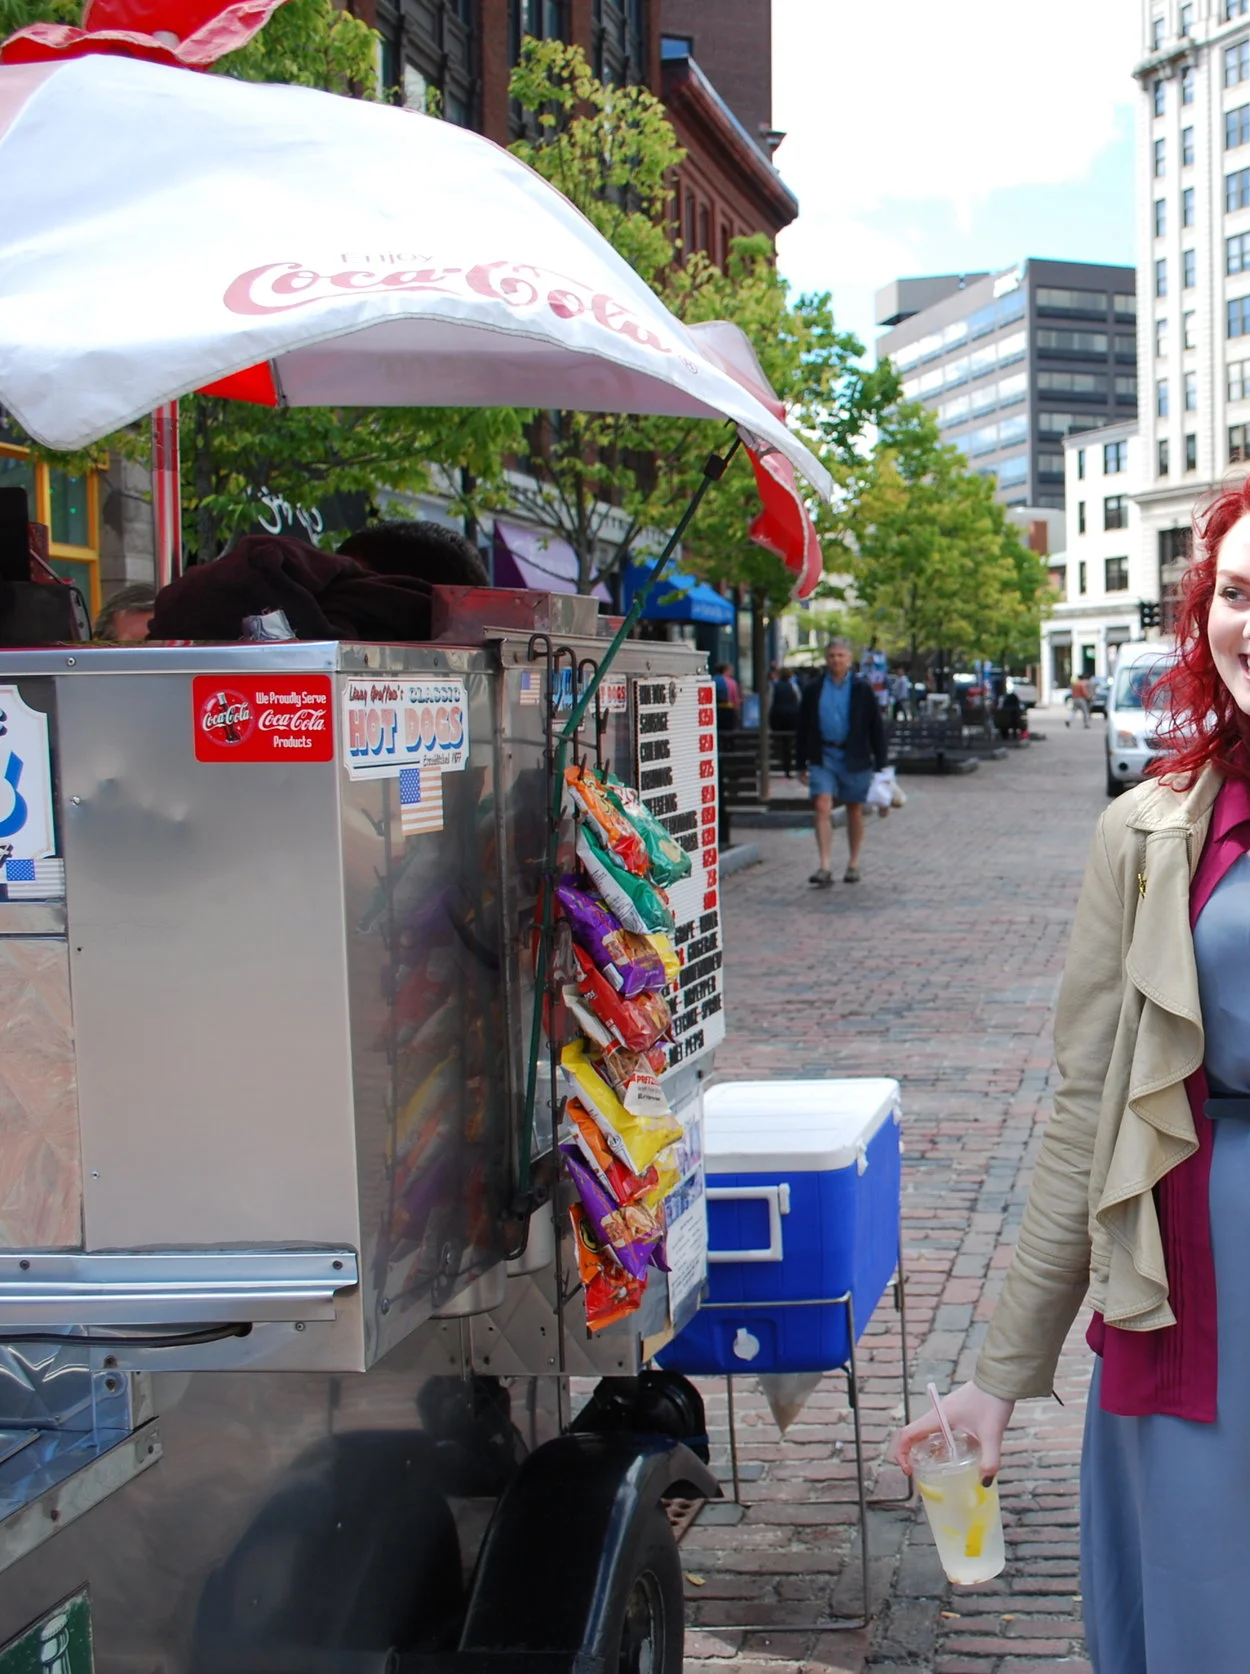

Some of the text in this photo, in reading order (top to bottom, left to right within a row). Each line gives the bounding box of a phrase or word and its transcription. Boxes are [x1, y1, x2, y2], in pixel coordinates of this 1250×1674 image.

[339, 250, 434, 265] Enjoy
[222, 260, 672, 354] Coca-Cola
[255, 691, 327, 707] We Proudly Serve
[408, 686, 461, 703] CLASSIC
[202, 701, 250, 732] Coca-Cola
[258, 709, 327, 731] Coca-Cola
[348, 706, 465, 756] HOT DOGS
[273, 735, 312, 748] Products
